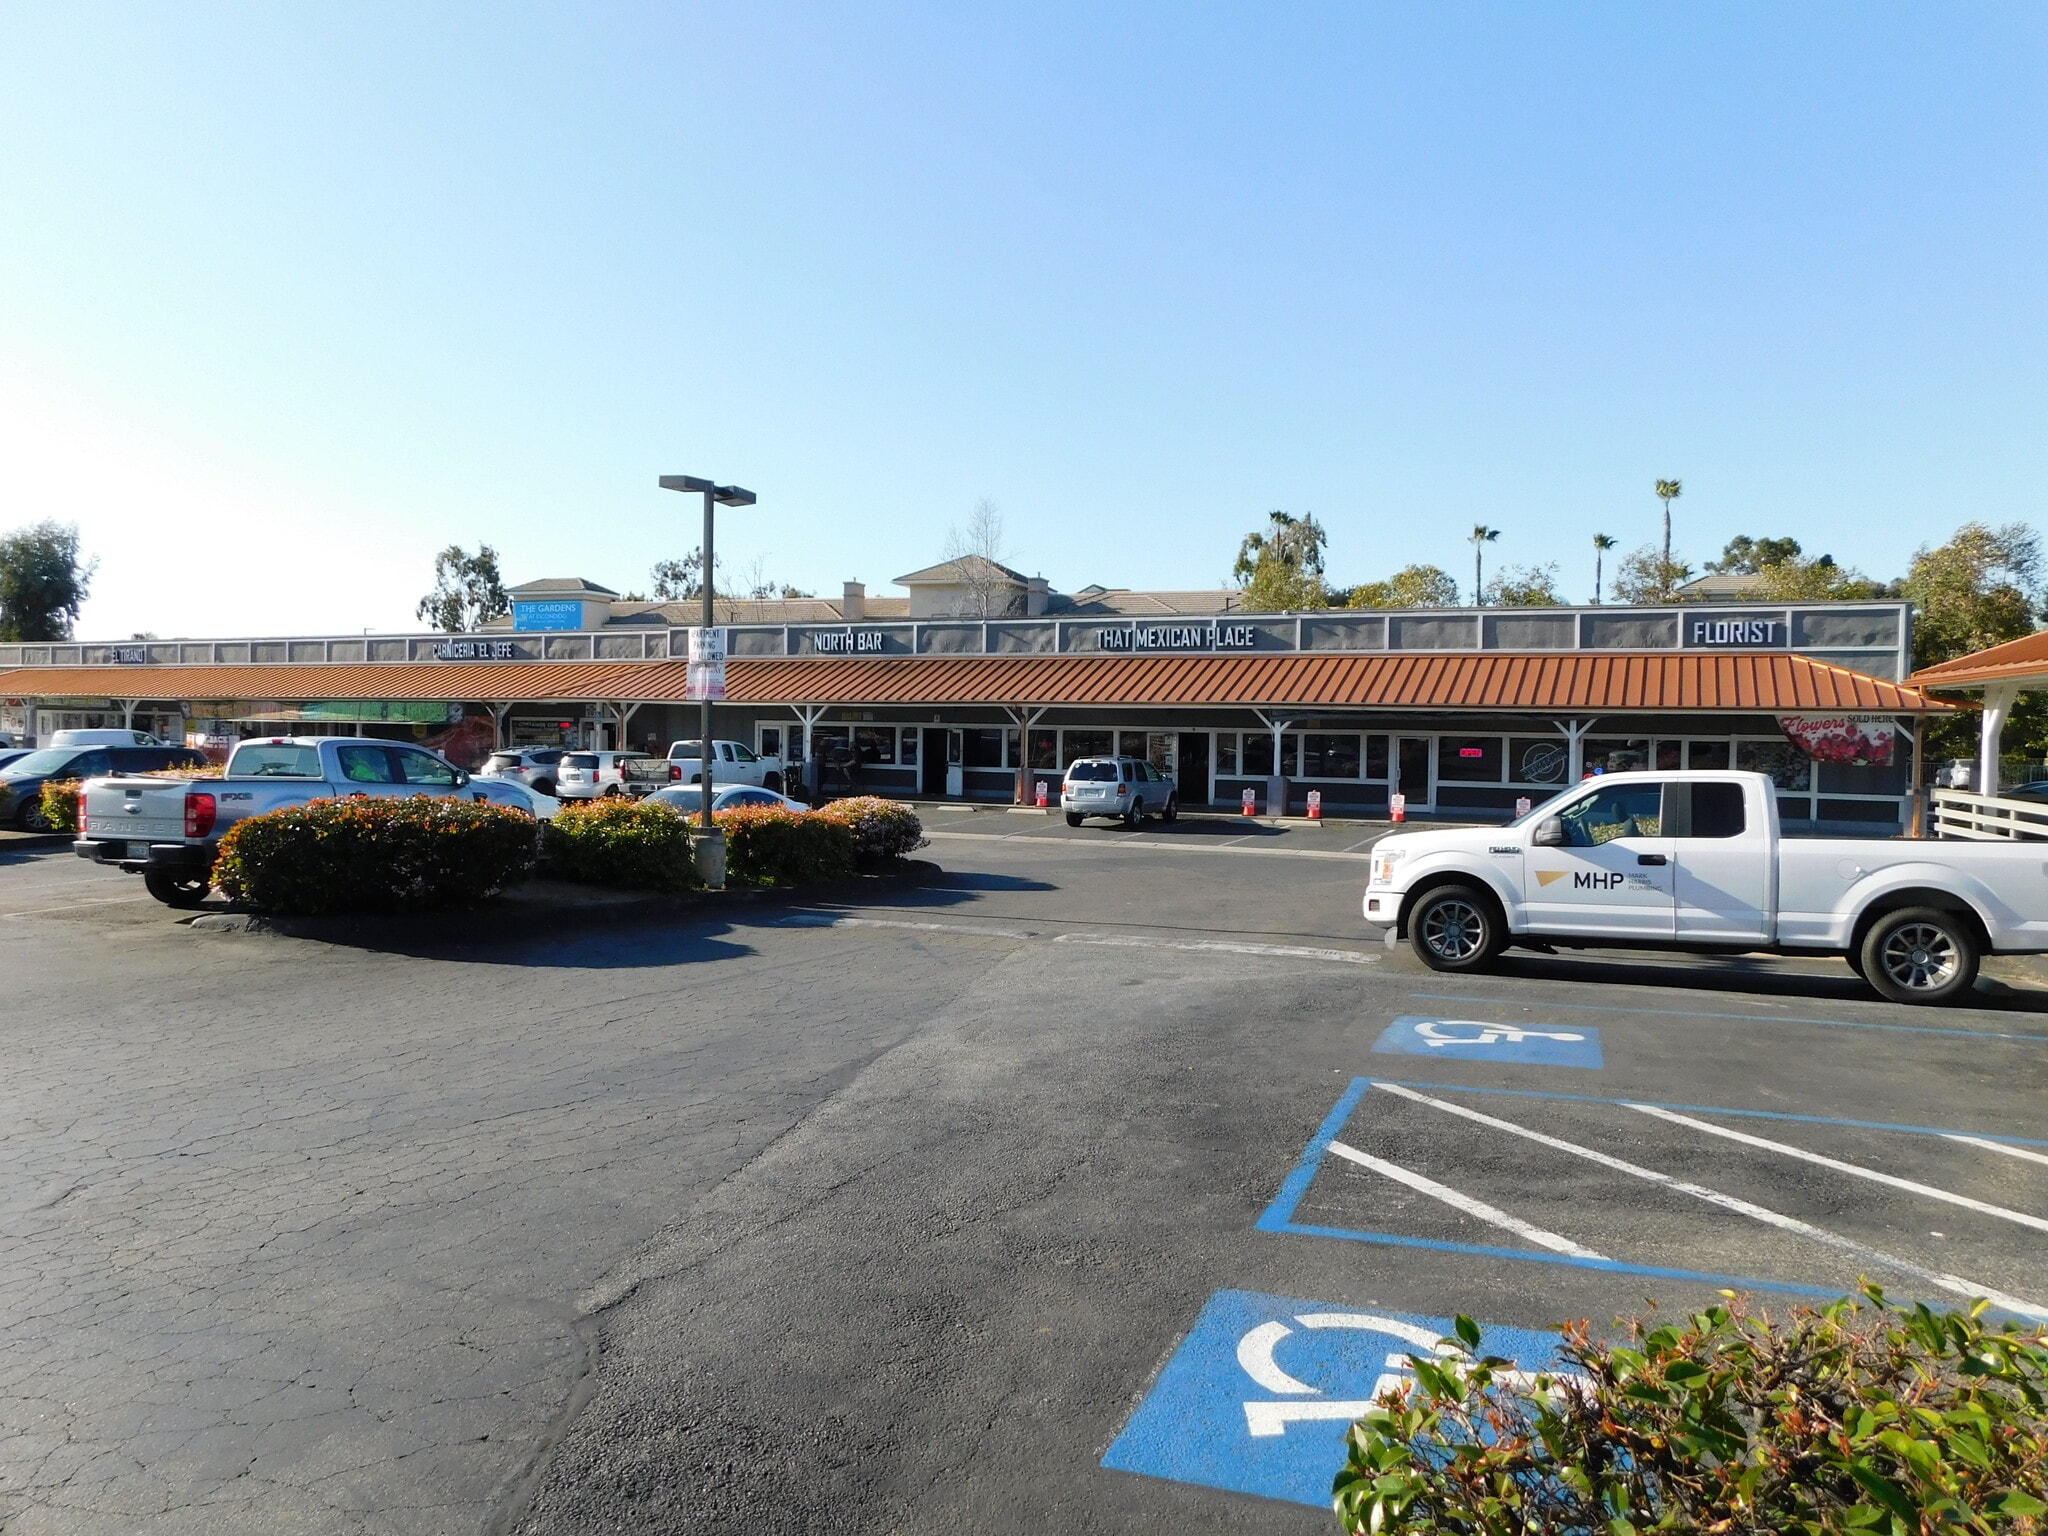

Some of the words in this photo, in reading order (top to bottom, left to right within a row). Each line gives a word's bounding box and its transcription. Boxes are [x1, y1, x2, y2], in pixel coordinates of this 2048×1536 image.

[521, 604, 535, 612] THE
[537, 604, 576, 612] GARDENS
[1096, 629, 1131, 648] THAT
[1136, 627, 1200, 647] MEXICAN
[1205, 626, 1253, 647] PLACE
[1693, 621, 1776, 643] FLORIST
[432, 643, 475, 658] CARNICERIA
[479, 643, 489, 658] EL
[491, 642, 512, 658] JEFE
[814, 632, 854, 651] NORTH
[857, 632, 882, 650] BAR
[1781, 715, 1846, 732] Flowers
[1847, 714, 1870, 724] SOLD
[1871, 714, 1894, 724] HERE
[89, 821, 183, 834] RANGER
[1574, 871, 1624, 890] MHP
